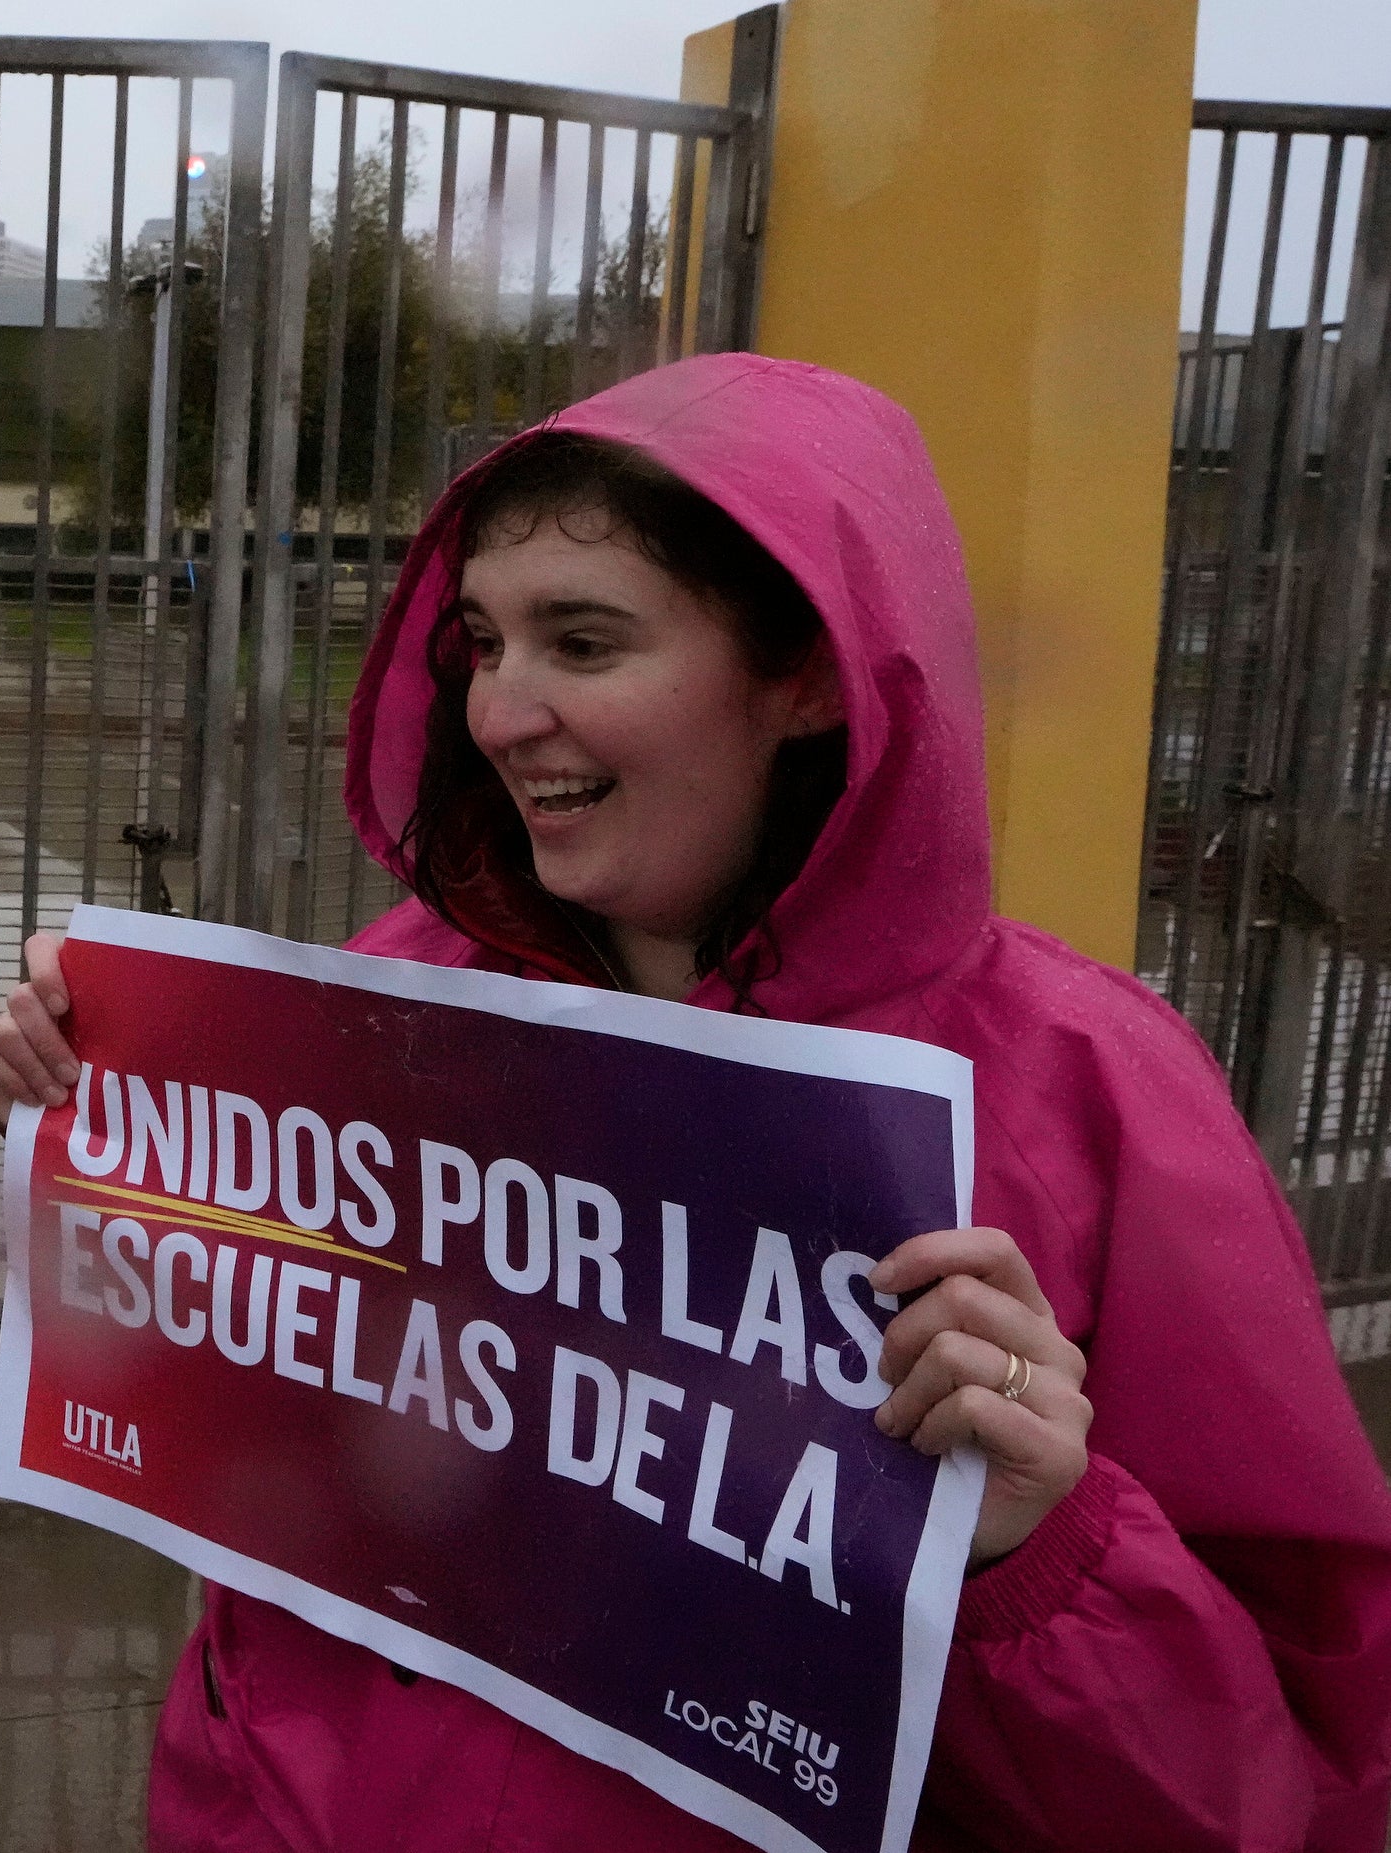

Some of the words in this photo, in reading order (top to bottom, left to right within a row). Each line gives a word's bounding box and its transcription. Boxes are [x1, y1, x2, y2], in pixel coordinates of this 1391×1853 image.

[67, 1061, 397, 1248] UNIDOS
[419, 1138, 627, 1325] POR
[661, 1200, 899, 1410] LAS
[59, 1202, 516, 1453] ESCUELAS
[547, 1345, 685, 1526] DE
[687, 1401, 851, 1616] L.A.
[63, 1399, 142, 1468] UTLA
[663, 1689, 781, 1775] LOCAL
[793, 1759, 838, 1807] 99
[744, 1700, 840, 1770] SEIU
